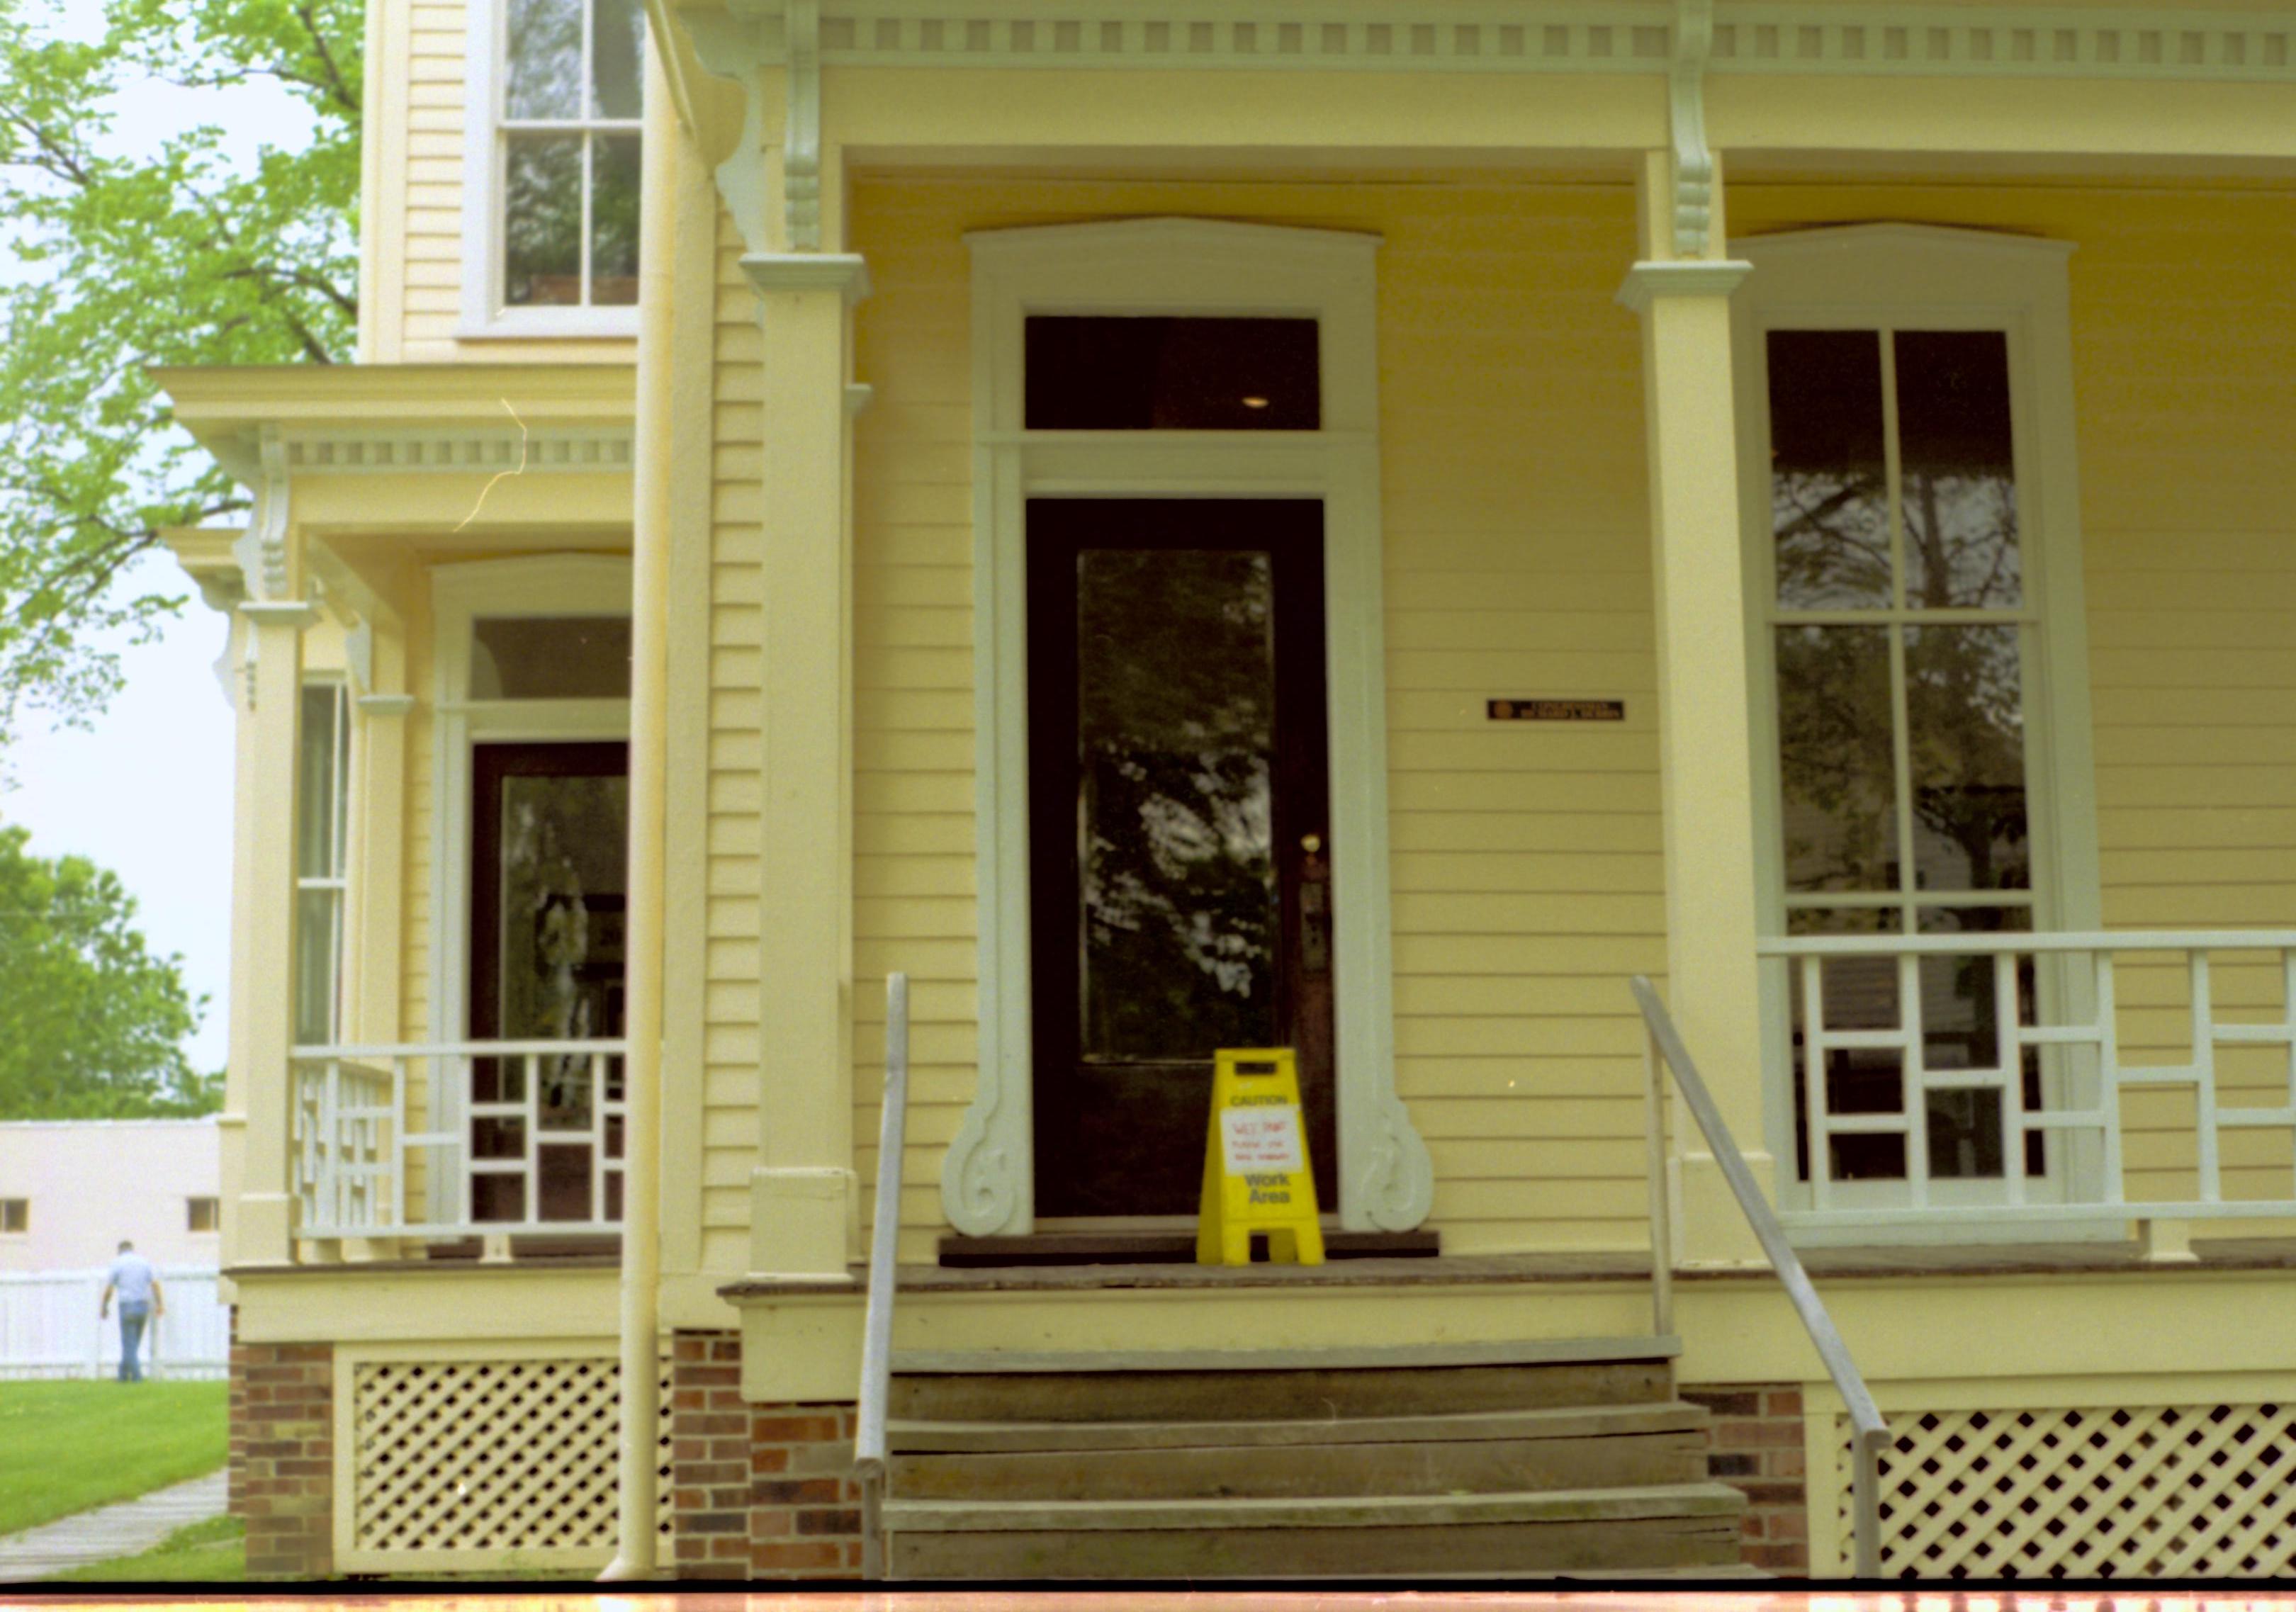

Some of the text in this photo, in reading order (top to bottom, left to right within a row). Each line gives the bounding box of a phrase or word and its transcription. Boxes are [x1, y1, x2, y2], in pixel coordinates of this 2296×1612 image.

[1230, 1095, 1288, 1106] CAUTION
[1244, 1173, 1290, 1188] Work
[1249, 1190, 1291, 1205] Area
